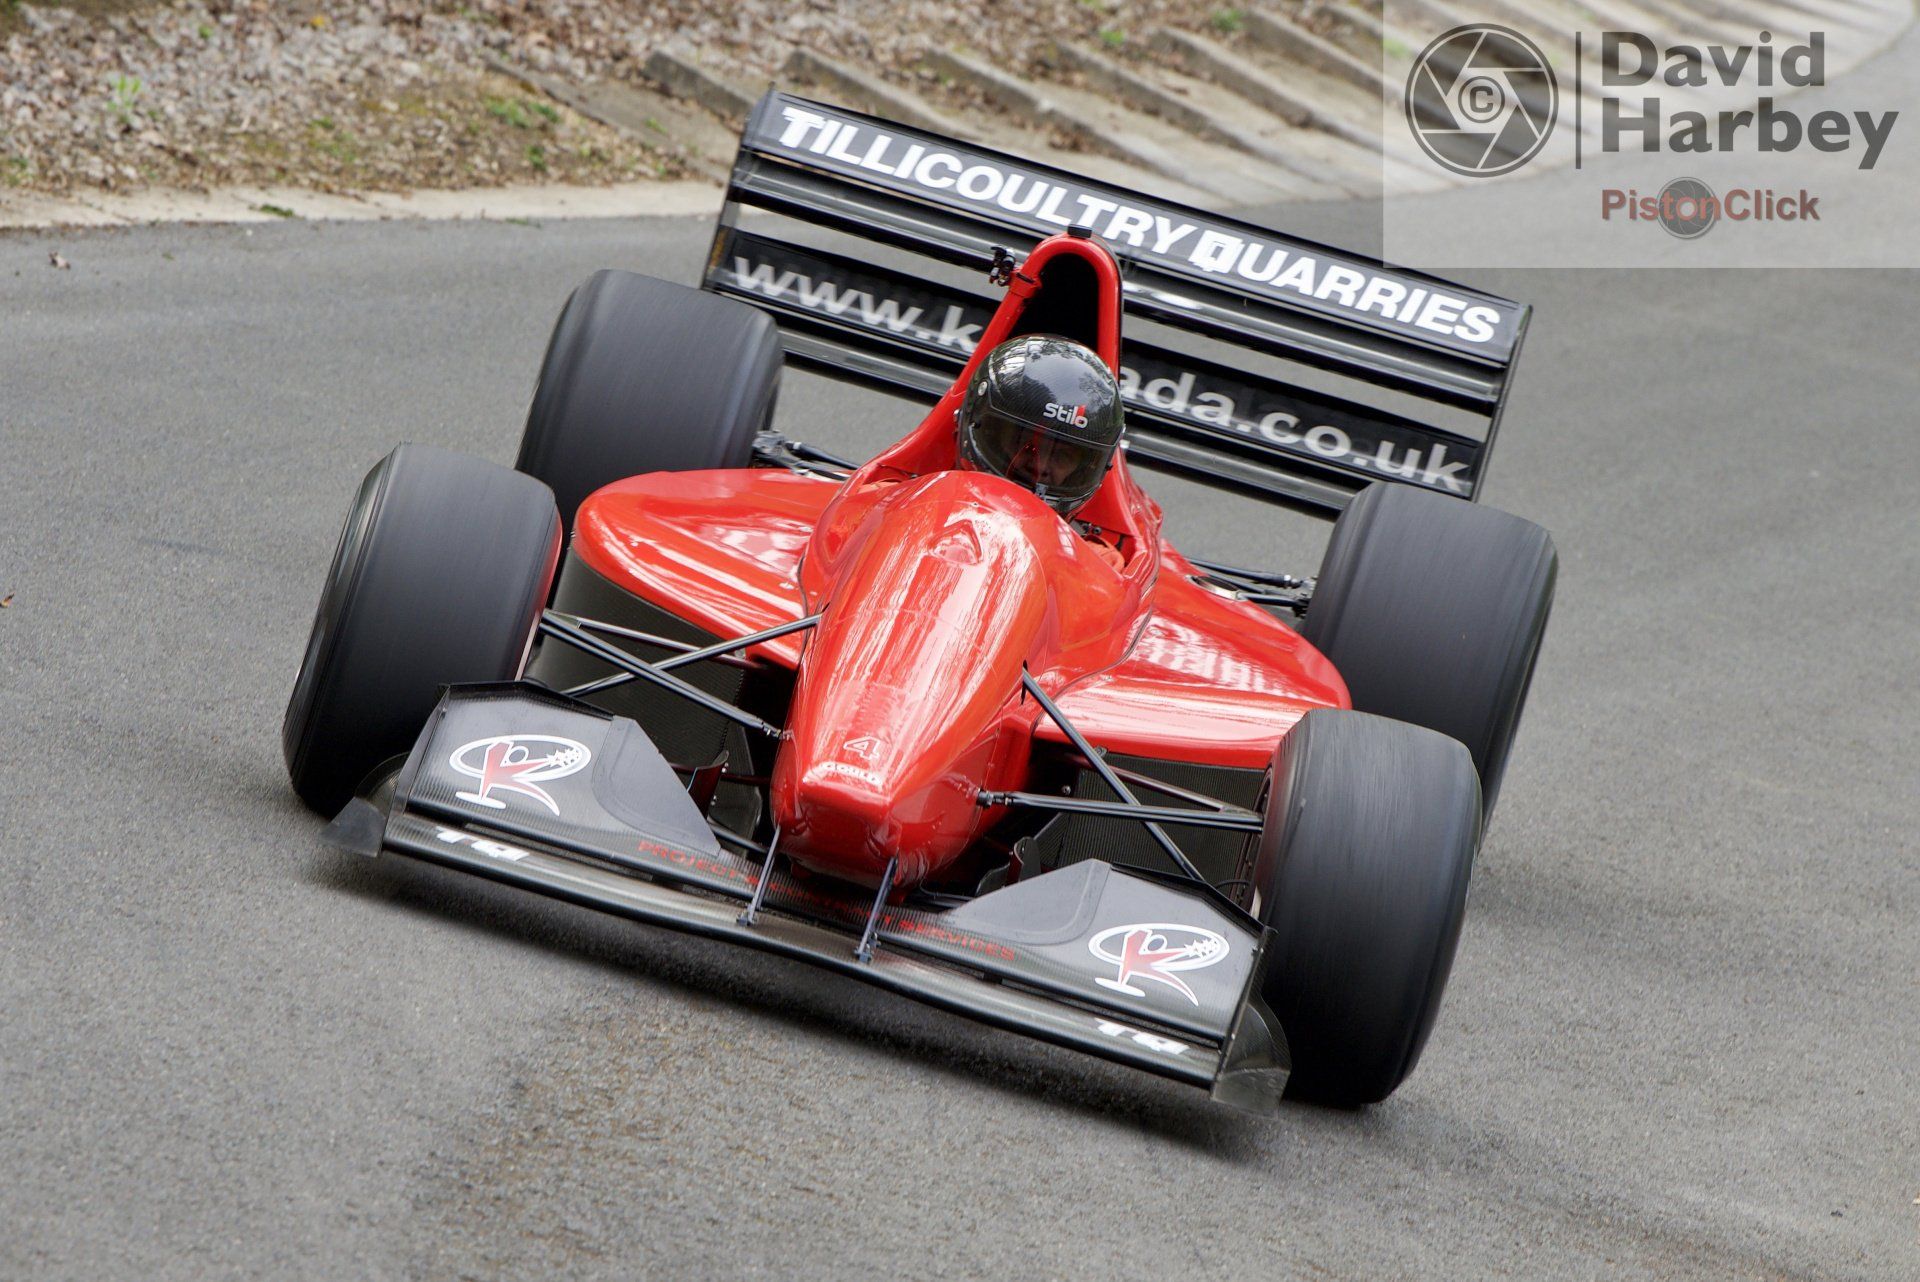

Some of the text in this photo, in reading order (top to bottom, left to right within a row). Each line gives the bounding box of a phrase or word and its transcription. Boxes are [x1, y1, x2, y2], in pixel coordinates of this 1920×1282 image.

[780, 106, 1501, 343] TILLICOULTRY QUARRIES
[1043, 402, 1088, 429] Stilo
